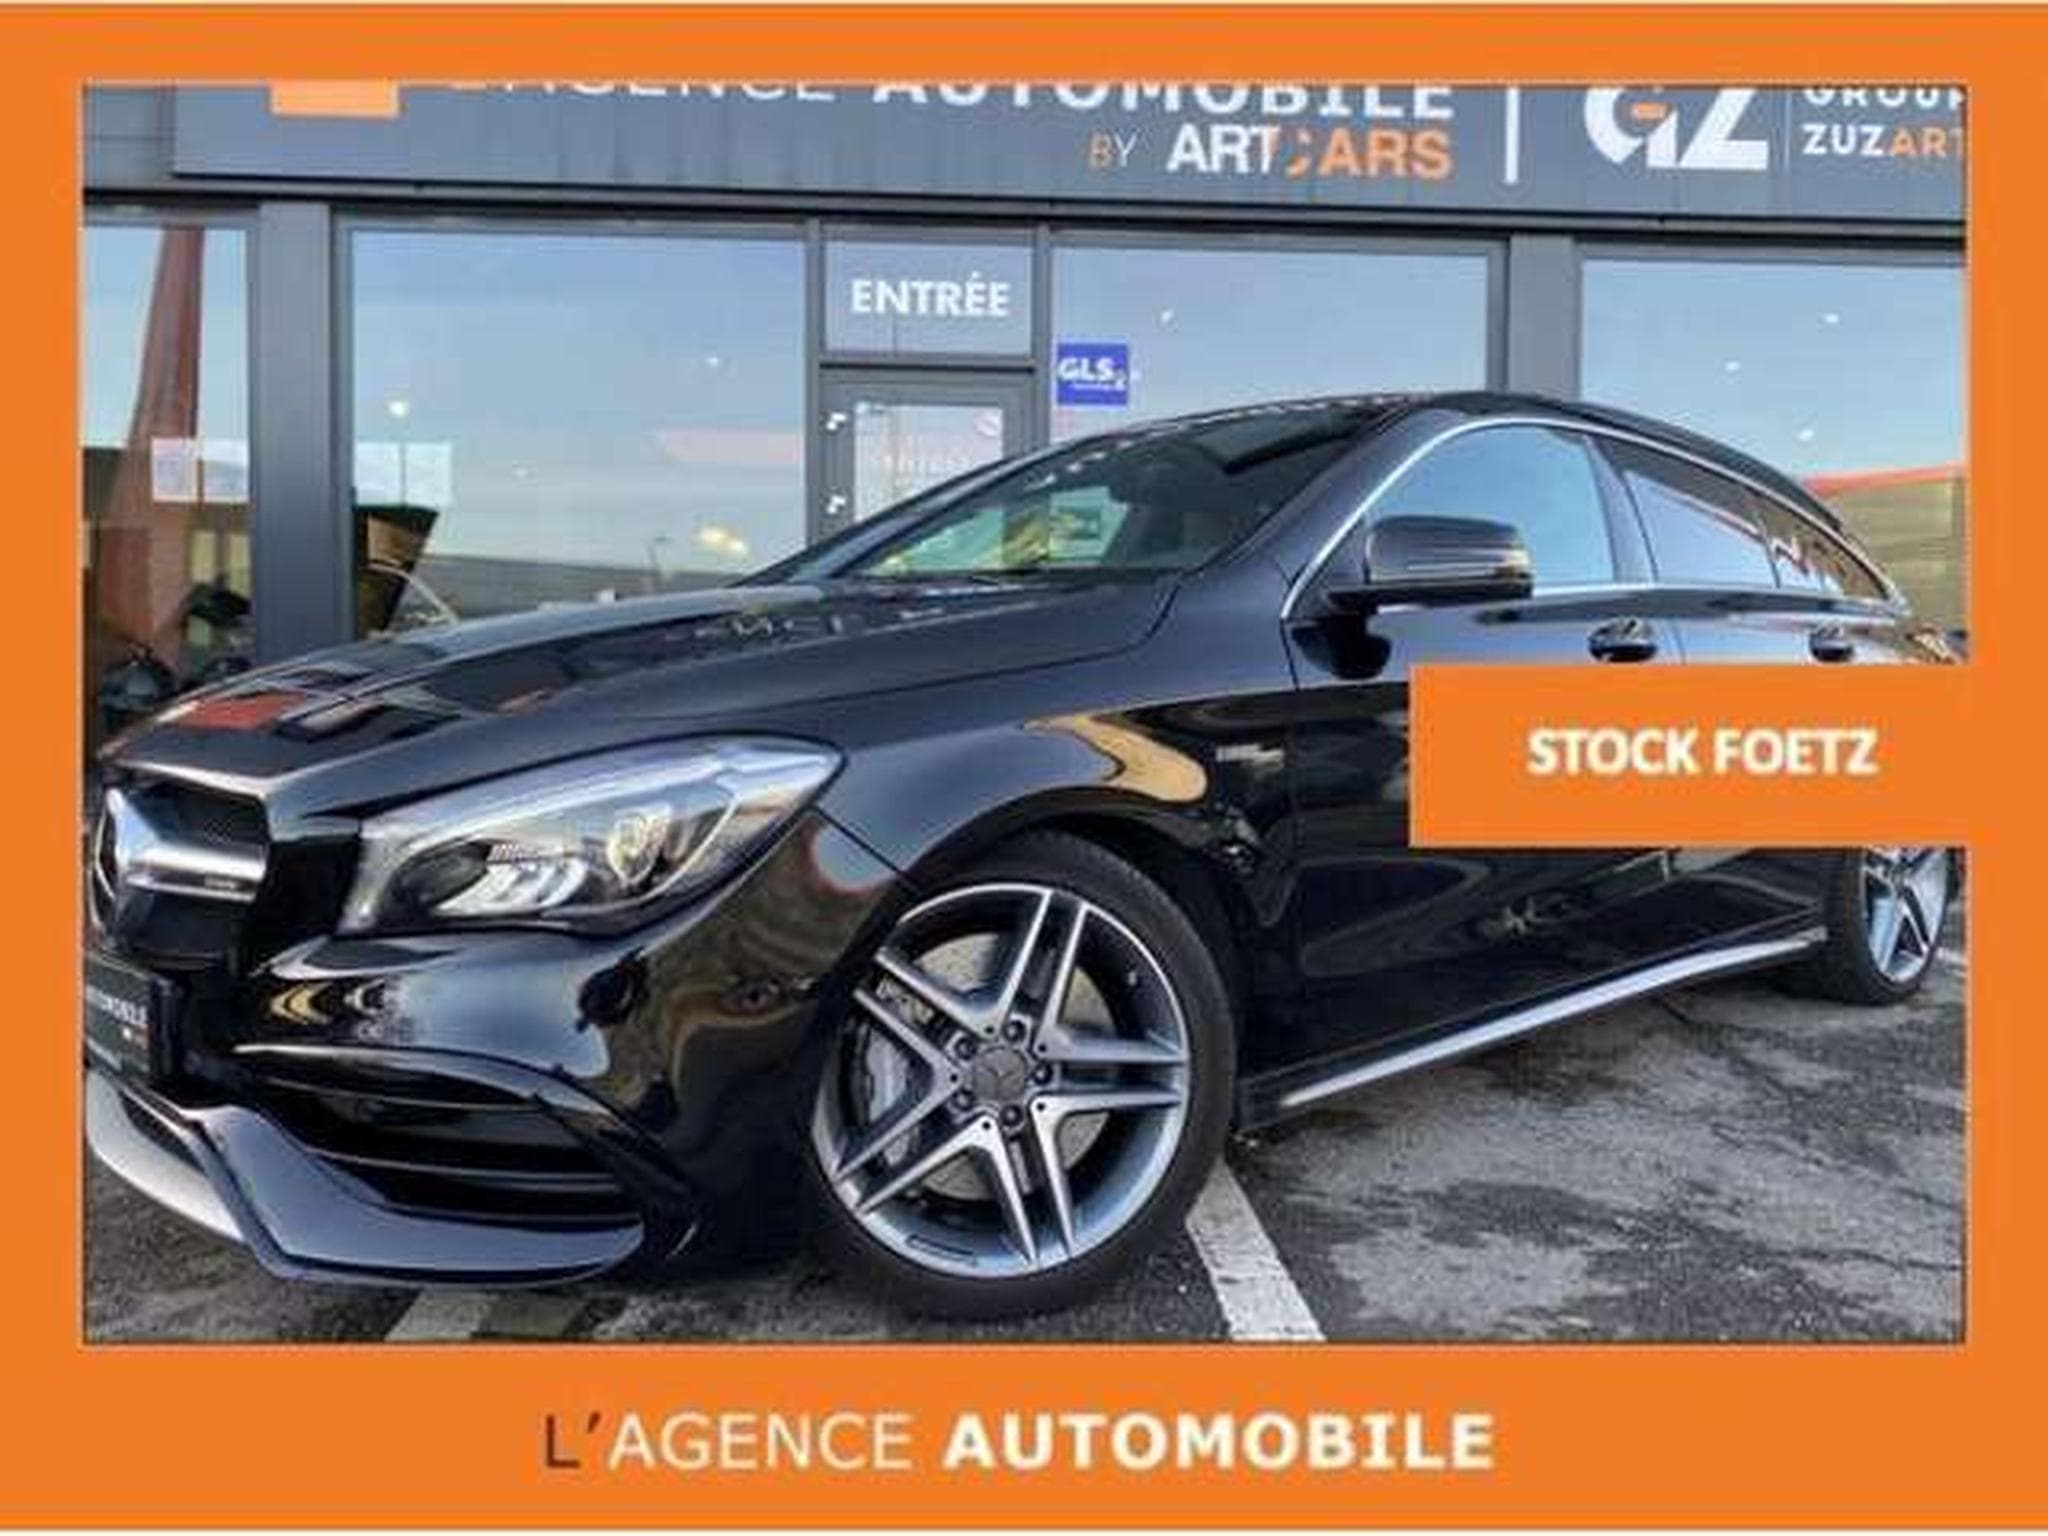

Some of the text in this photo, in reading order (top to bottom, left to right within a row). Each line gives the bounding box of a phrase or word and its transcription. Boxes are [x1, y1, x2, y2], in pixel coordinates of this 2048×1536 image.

[1088, 132, 1137, 173] BY
[850, 271, 1012, 317] ENTRÉE
[1058, 357, 1114, 381] GLS
